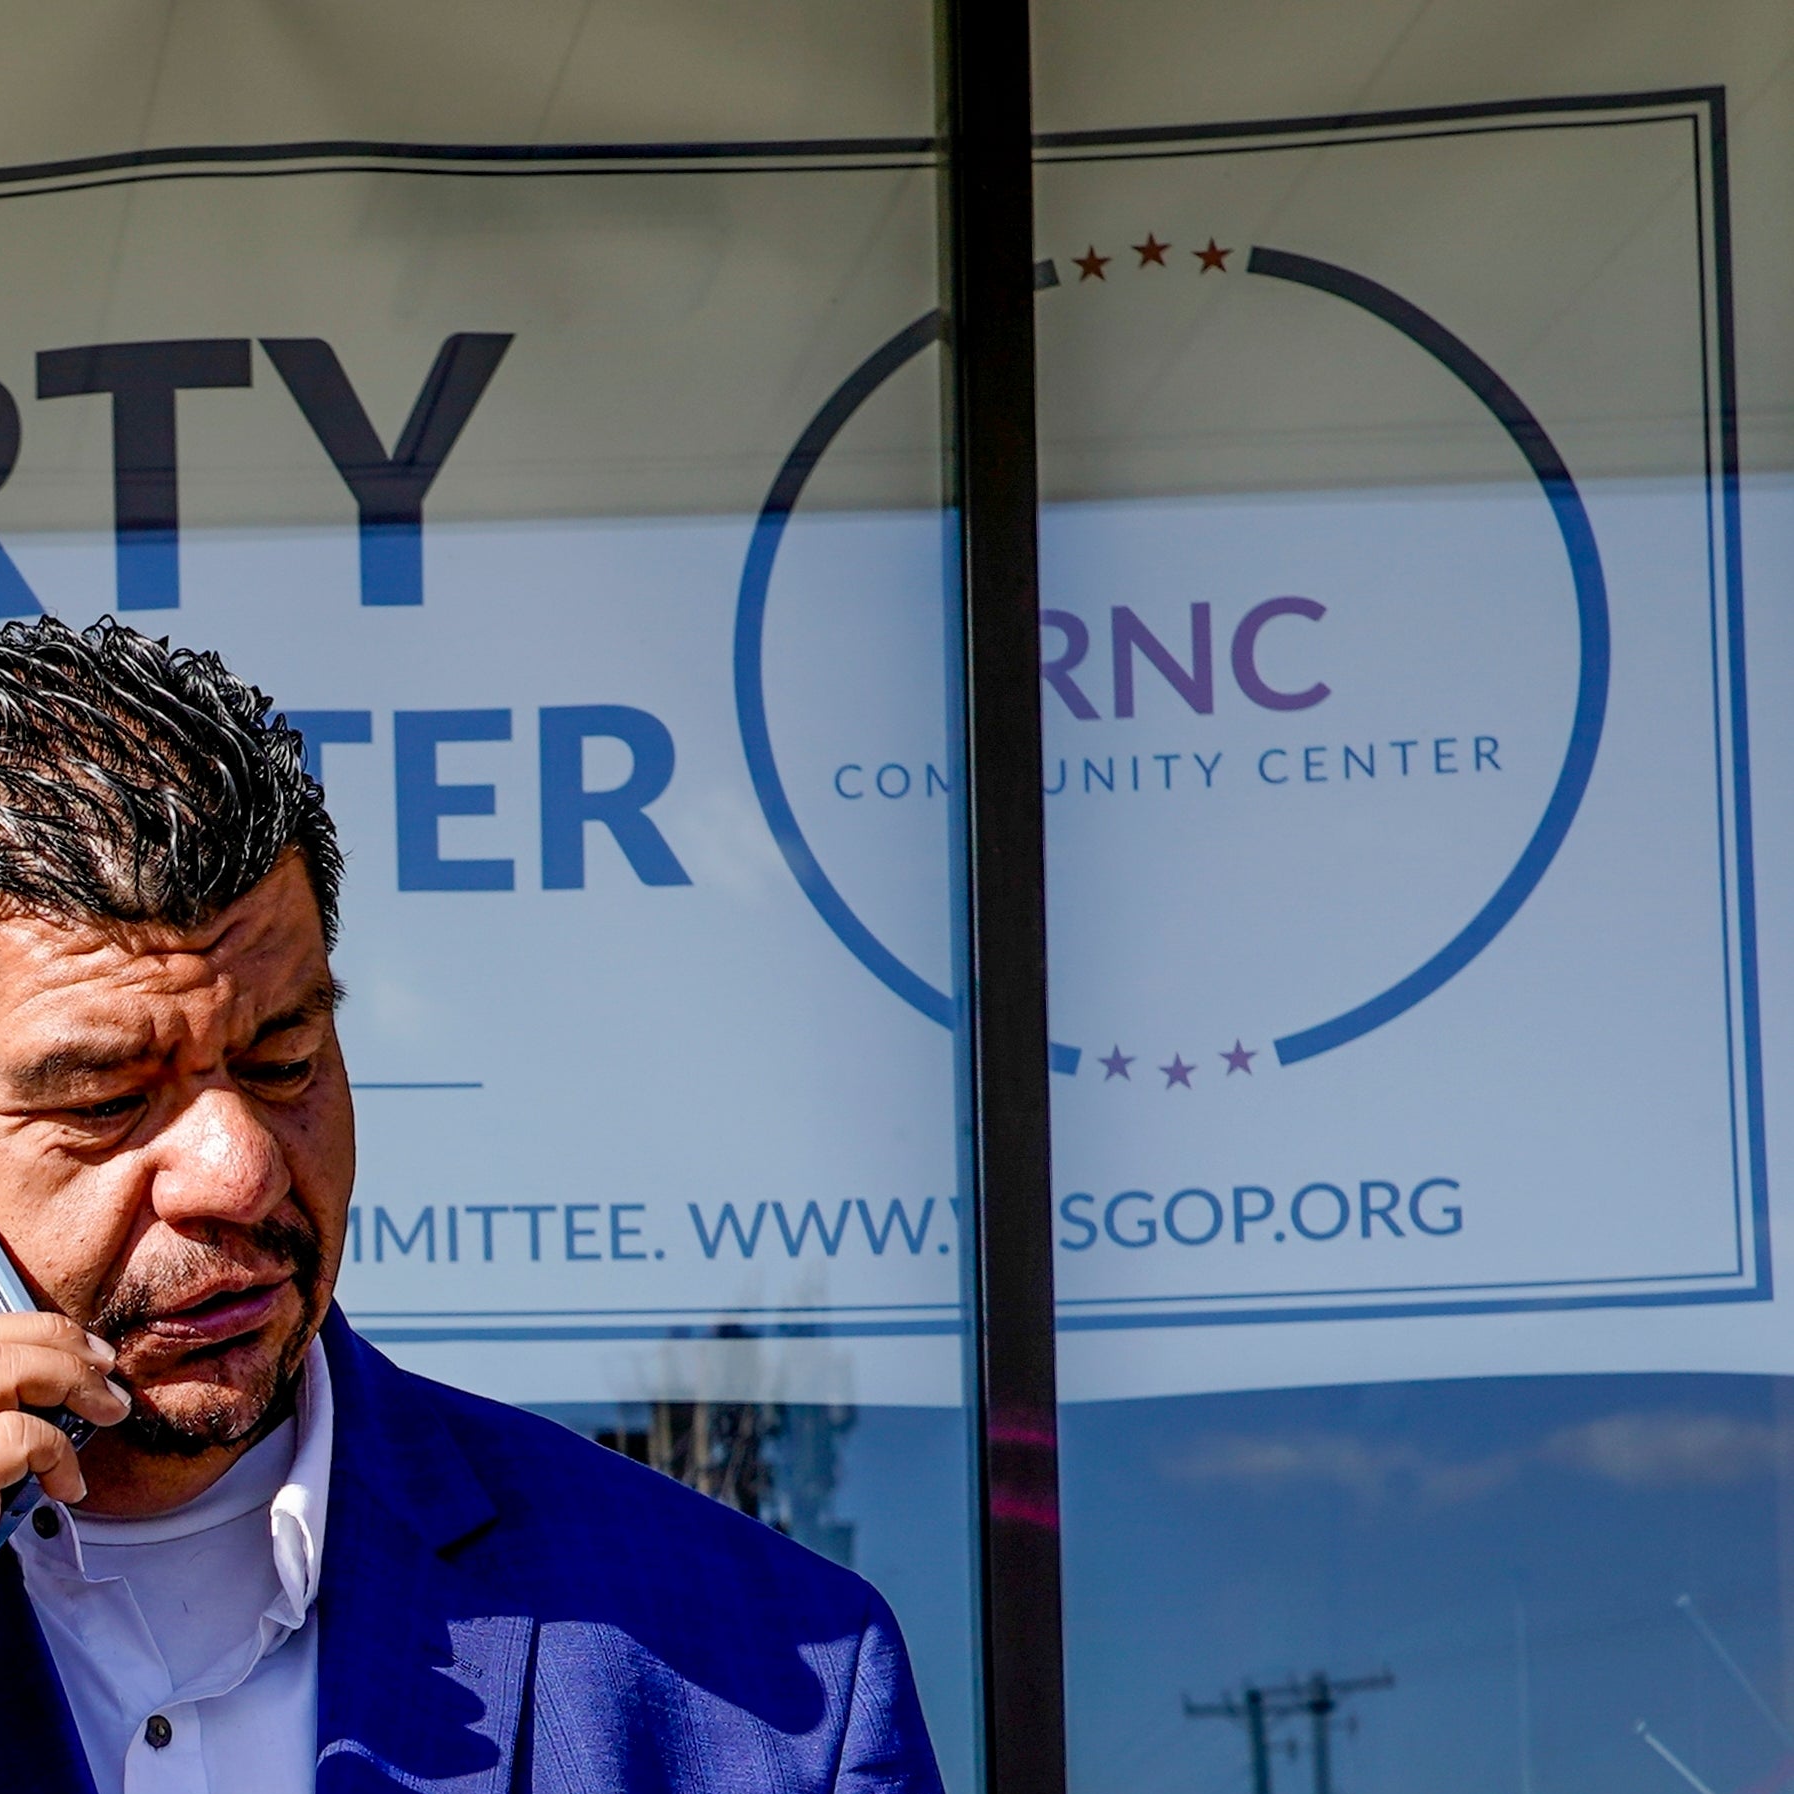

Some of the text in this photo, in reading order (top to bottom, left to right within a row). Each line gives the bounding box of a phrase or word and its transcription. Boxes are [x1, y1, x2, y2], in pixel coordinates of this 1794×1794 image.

[834, 735, 1503, 799] COMUNITY CENTER
[347, 1202, 667, 1264] MITTEE.
[687, 1176, 1465, 1261] WWW.SGOP.ORG
